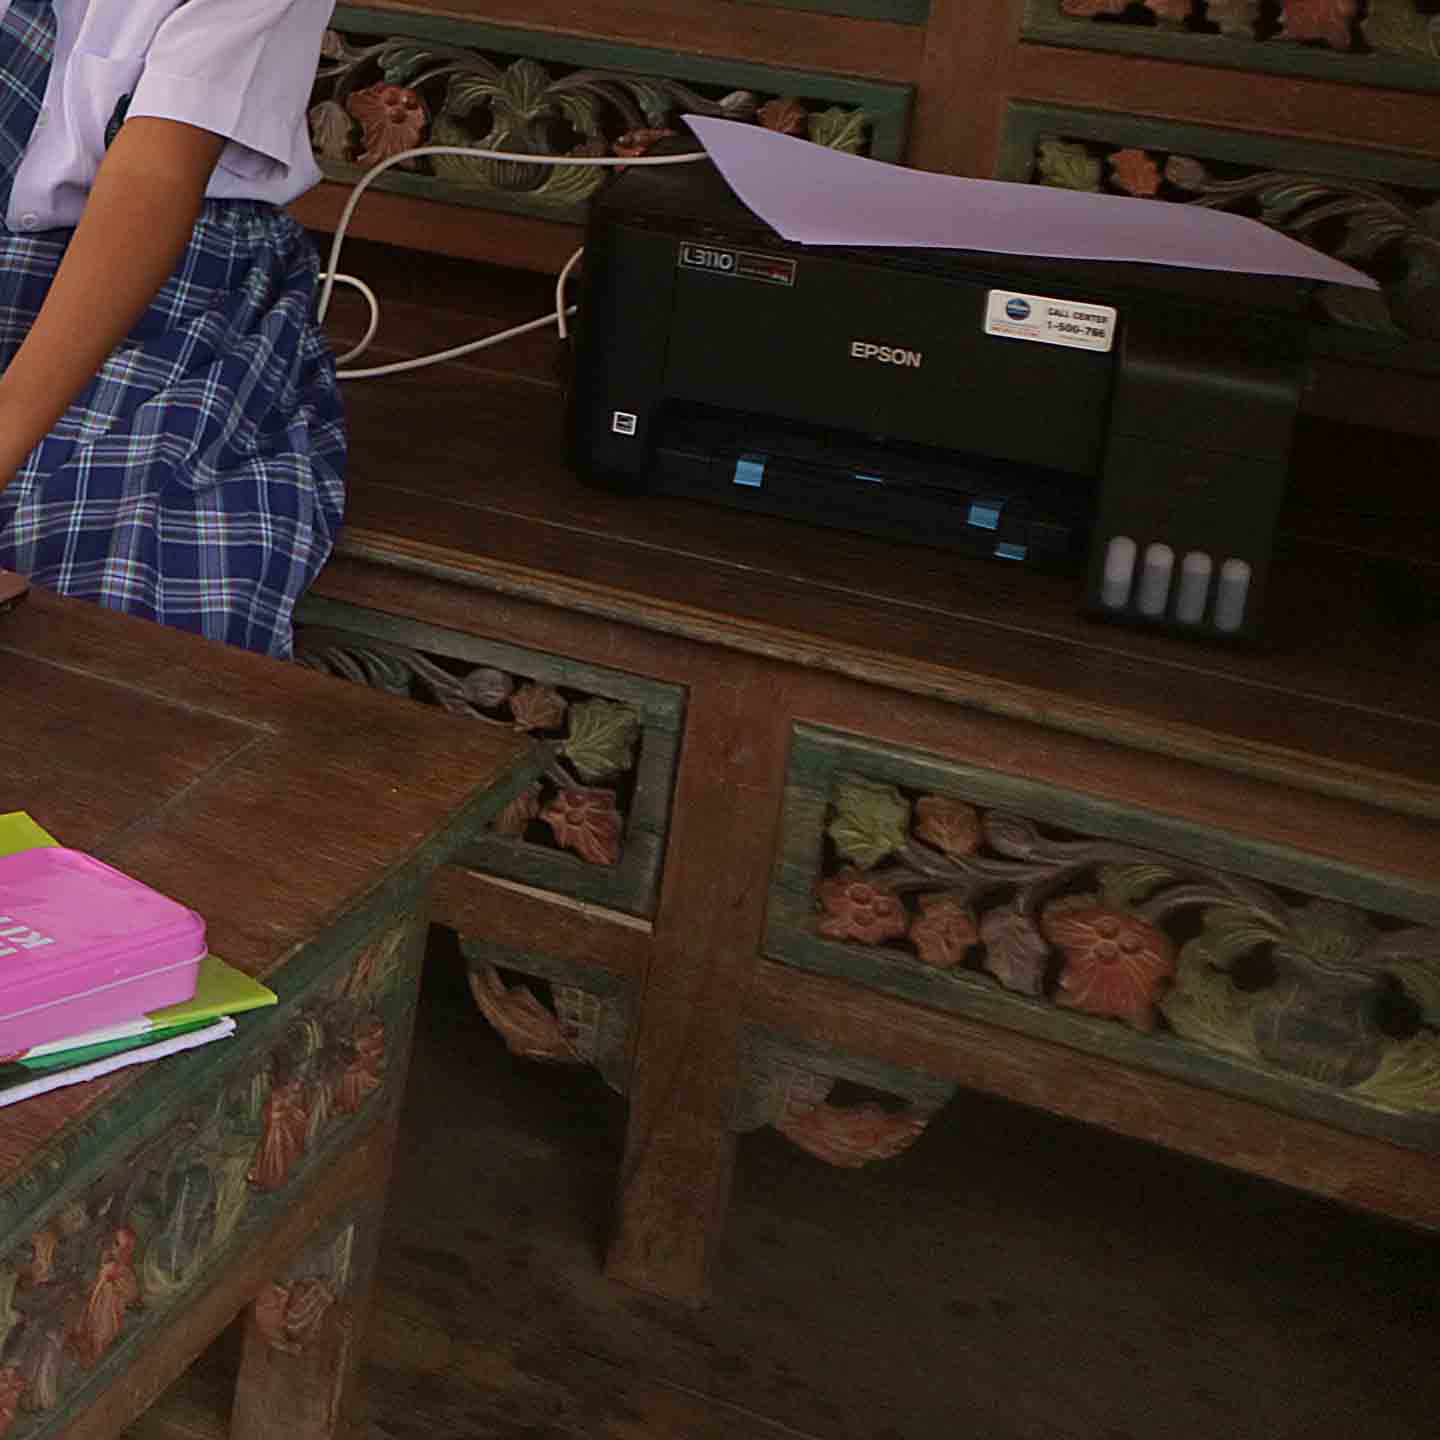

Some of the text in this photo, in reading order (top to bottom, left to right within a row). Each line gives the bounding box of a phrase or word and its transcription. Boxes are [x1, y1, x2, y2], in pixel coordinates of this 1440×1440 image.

[683, 247, 734, 271] L3110
[1047, 307, 1109, 324] CALL CENTER
[851, 341, 923, 369] EPSON
